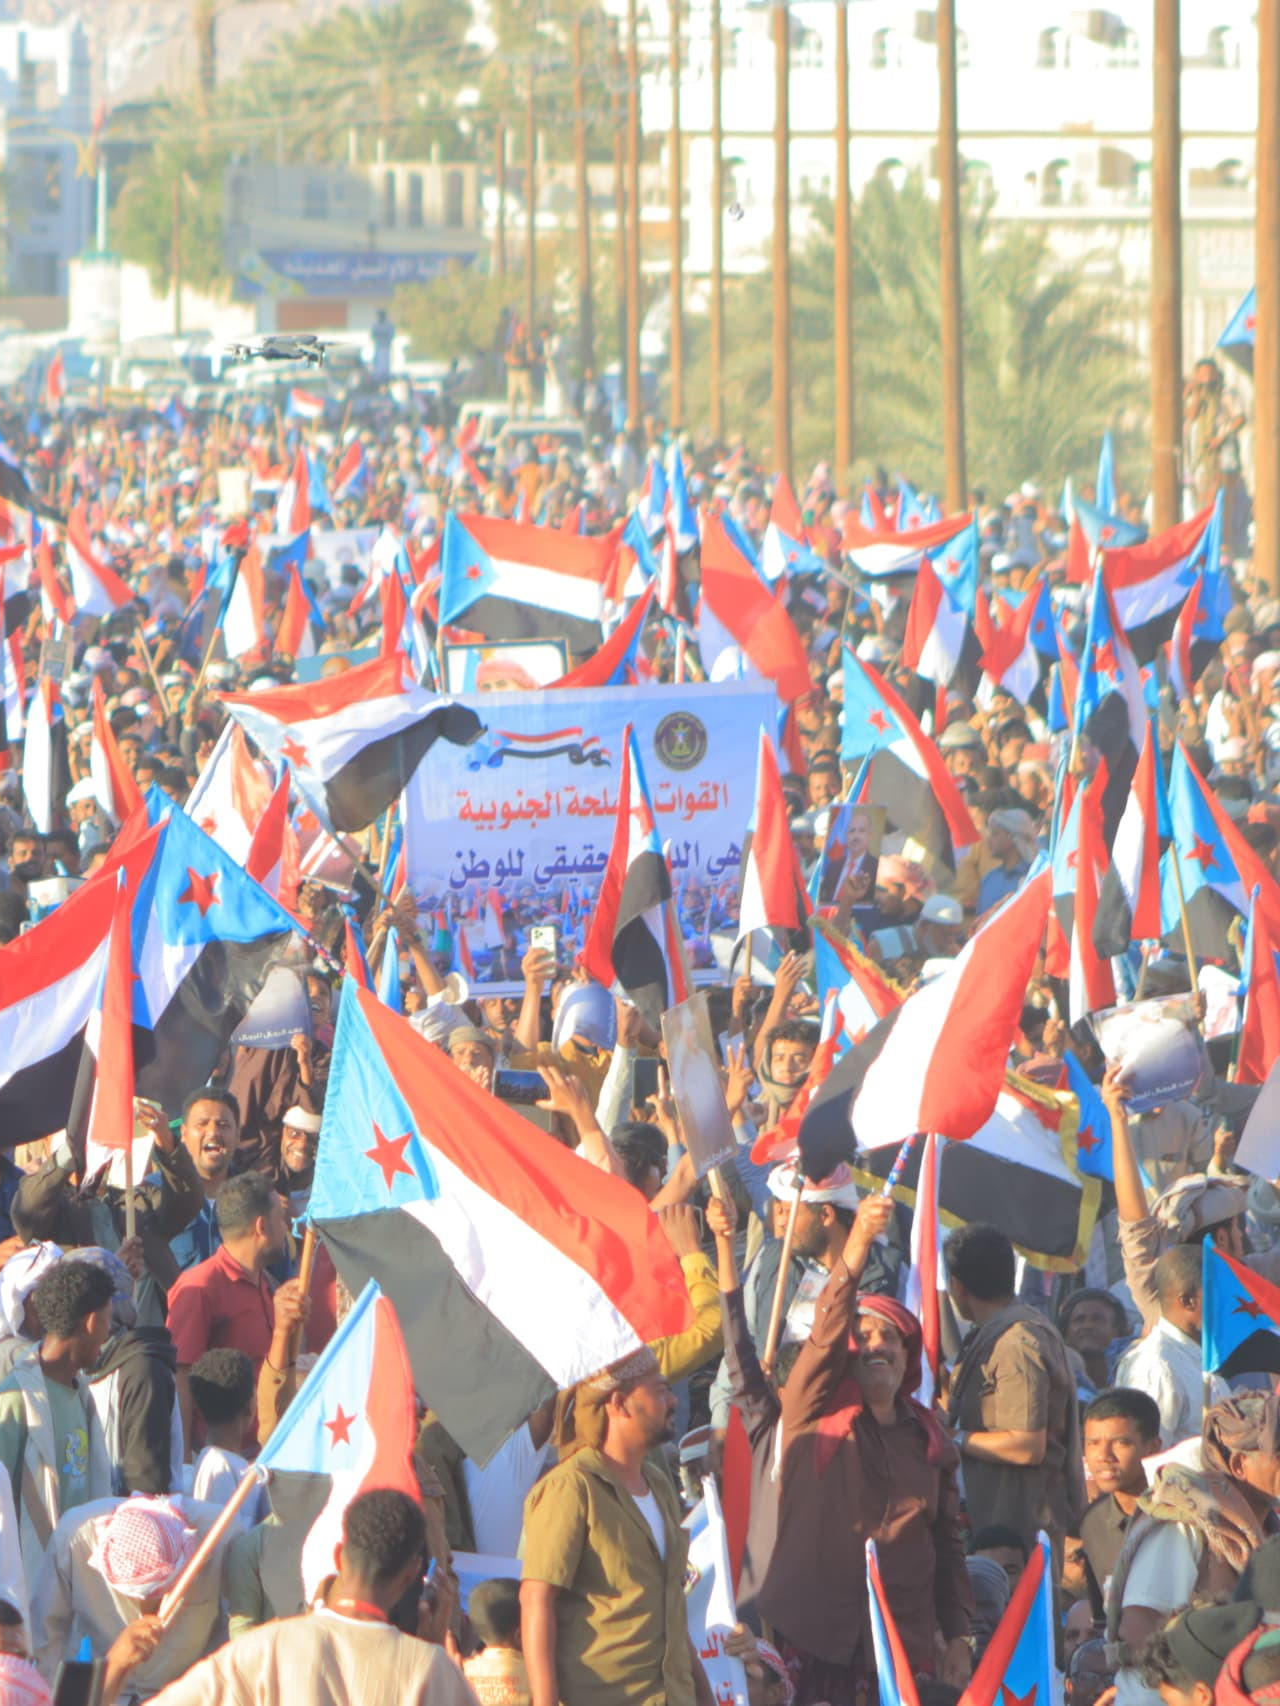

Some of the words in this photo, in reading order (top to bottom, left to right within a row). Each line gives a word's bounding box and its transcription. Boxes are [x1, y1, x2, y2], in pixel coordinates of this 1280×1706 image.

[456, 789, 561, 831] الجنوبية
[654, 781, 728, 821] القوات
[449, 848, 525, 890] للوطن
[534, 844, 609, 890] حقيقي
[706, 841, 742, 882] هي
